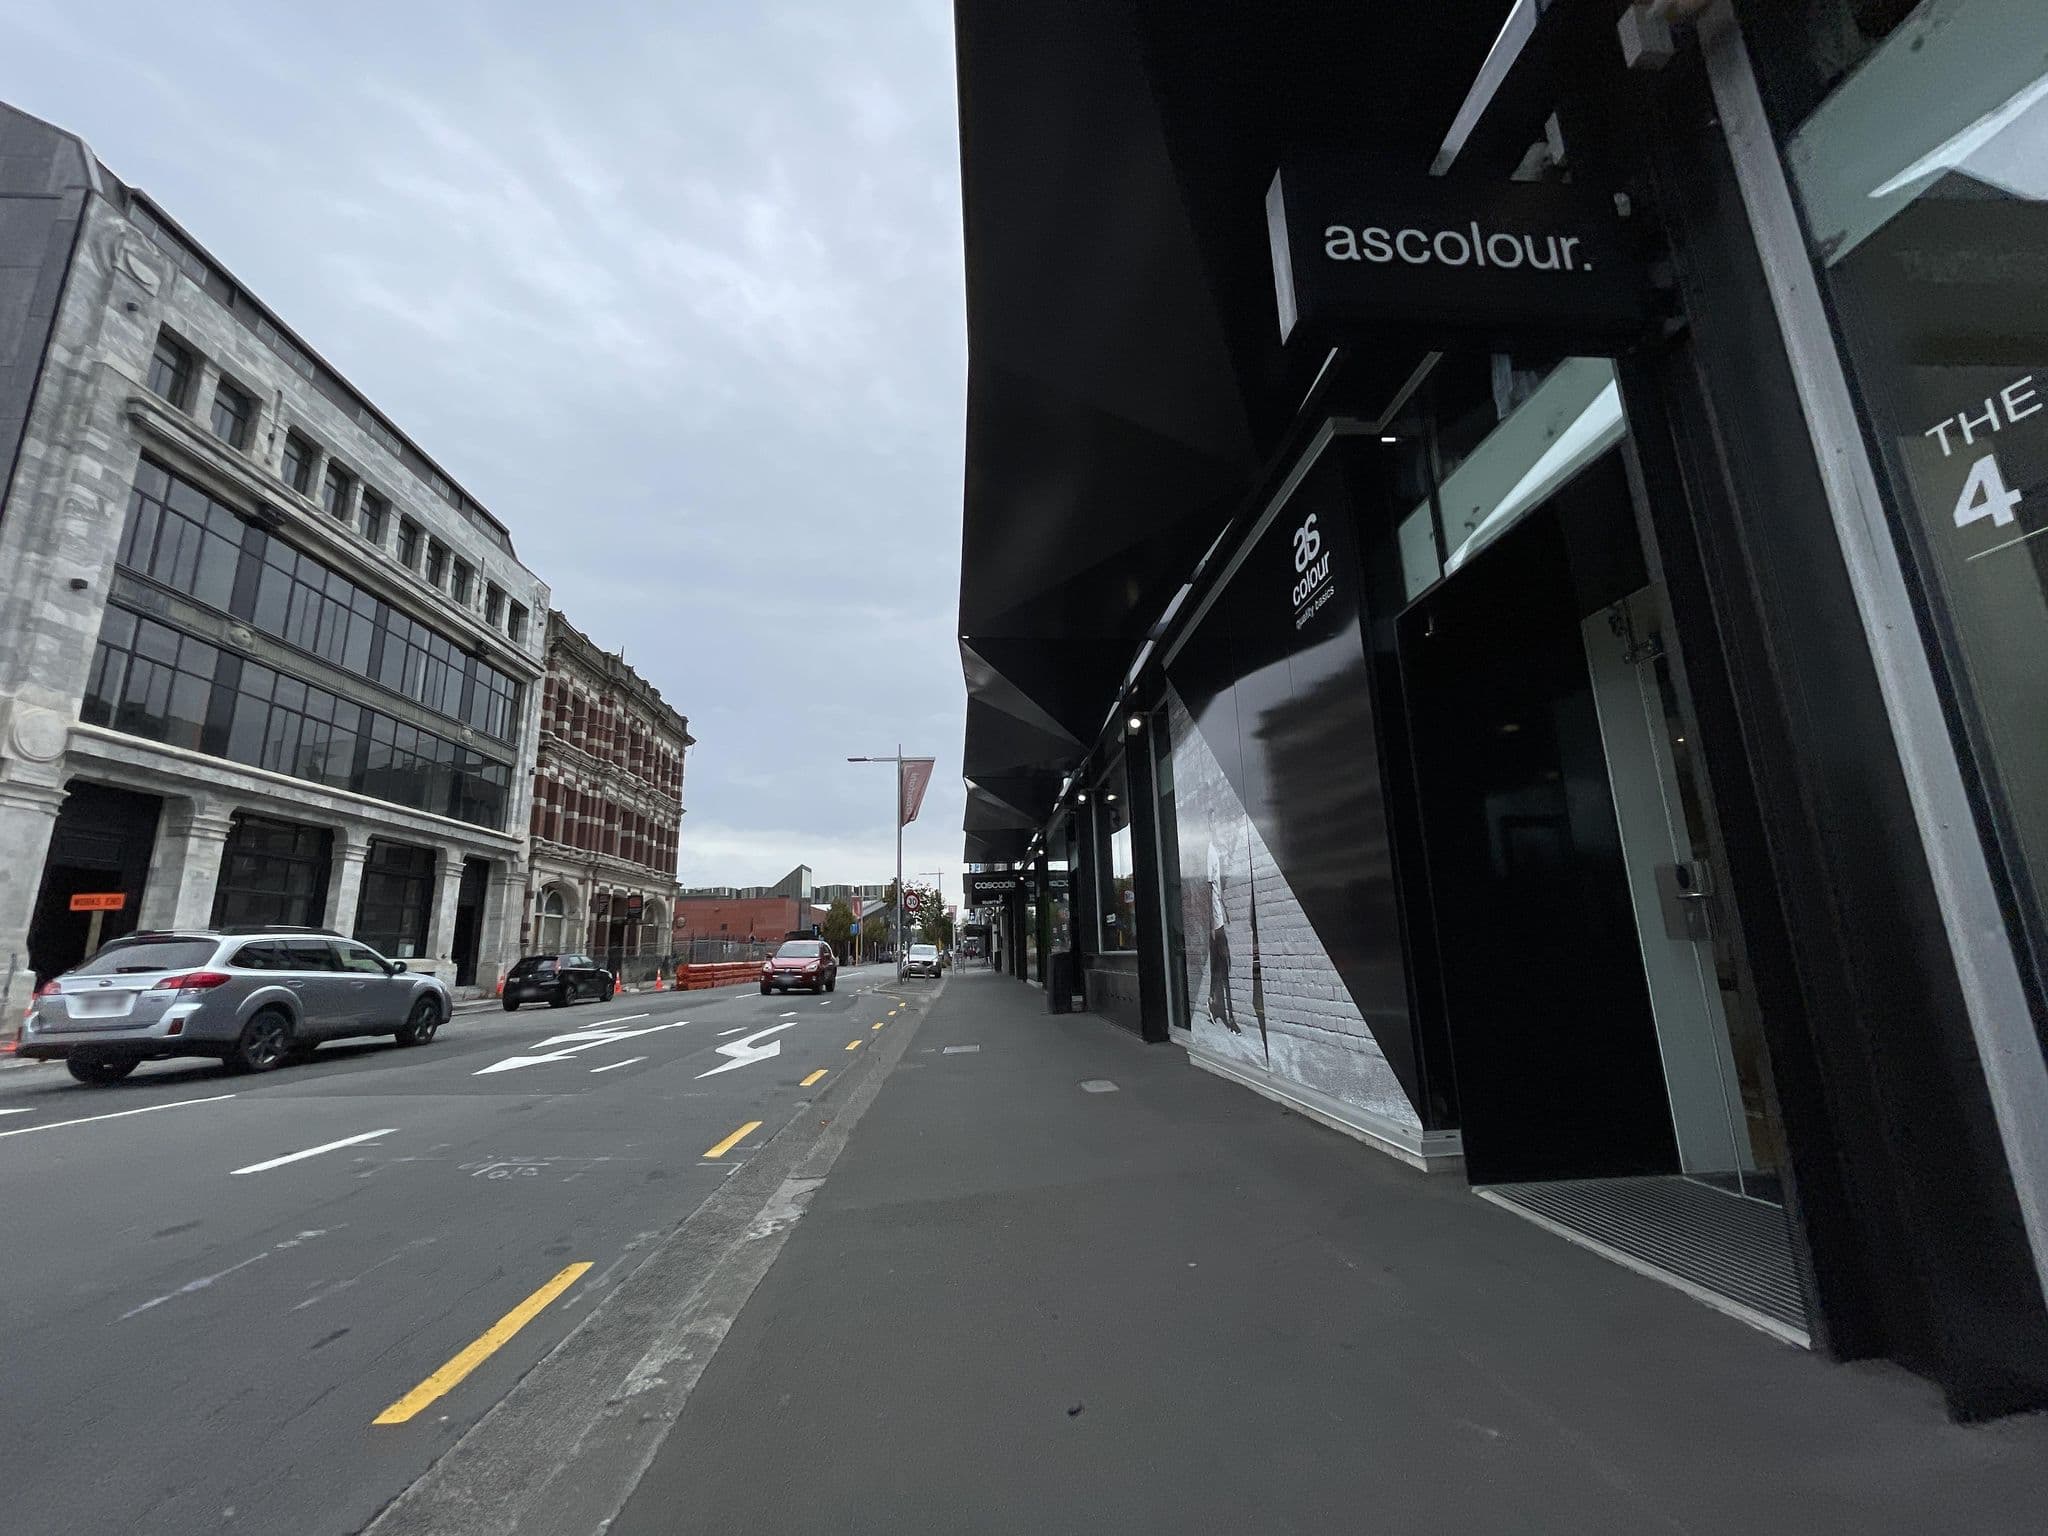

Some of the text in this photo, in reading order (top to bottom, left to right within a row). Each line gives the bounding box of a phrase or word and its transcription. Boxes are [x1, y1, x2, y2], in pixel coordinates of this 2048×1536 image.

[1324, 220, 1592, 271] ascolour.
[1924, 375, 2043, 457] THE
[1953, 453, 2023, 528] 4
[1293, 550, 1330, 606] colour
